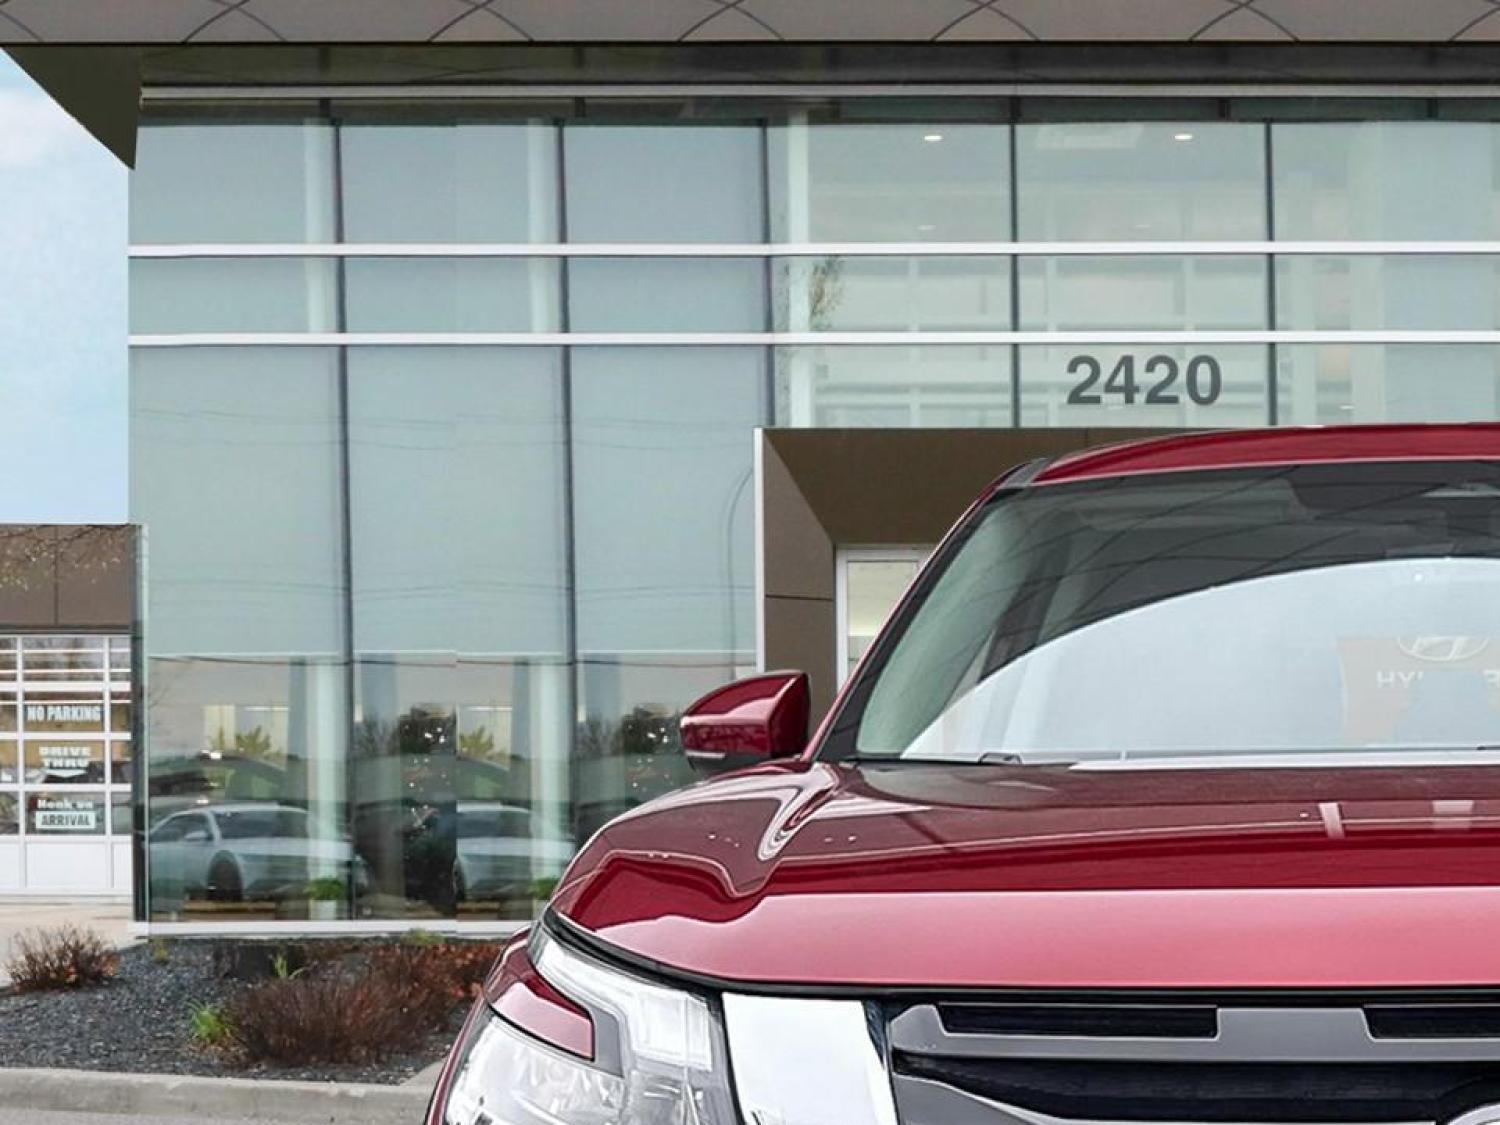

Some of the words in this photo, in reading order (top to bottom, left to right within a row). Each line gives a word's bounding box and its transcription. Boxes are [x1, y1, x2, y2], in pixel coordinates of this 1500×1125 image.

[1067, 355, 1222, 405] 2420
[27, 705, 45, 721] NO
[47, 705, 101, 721] PARKING
[39, 746, 91, 757] DRIVE
[41, 813, 90, 826] ARRIVAL
